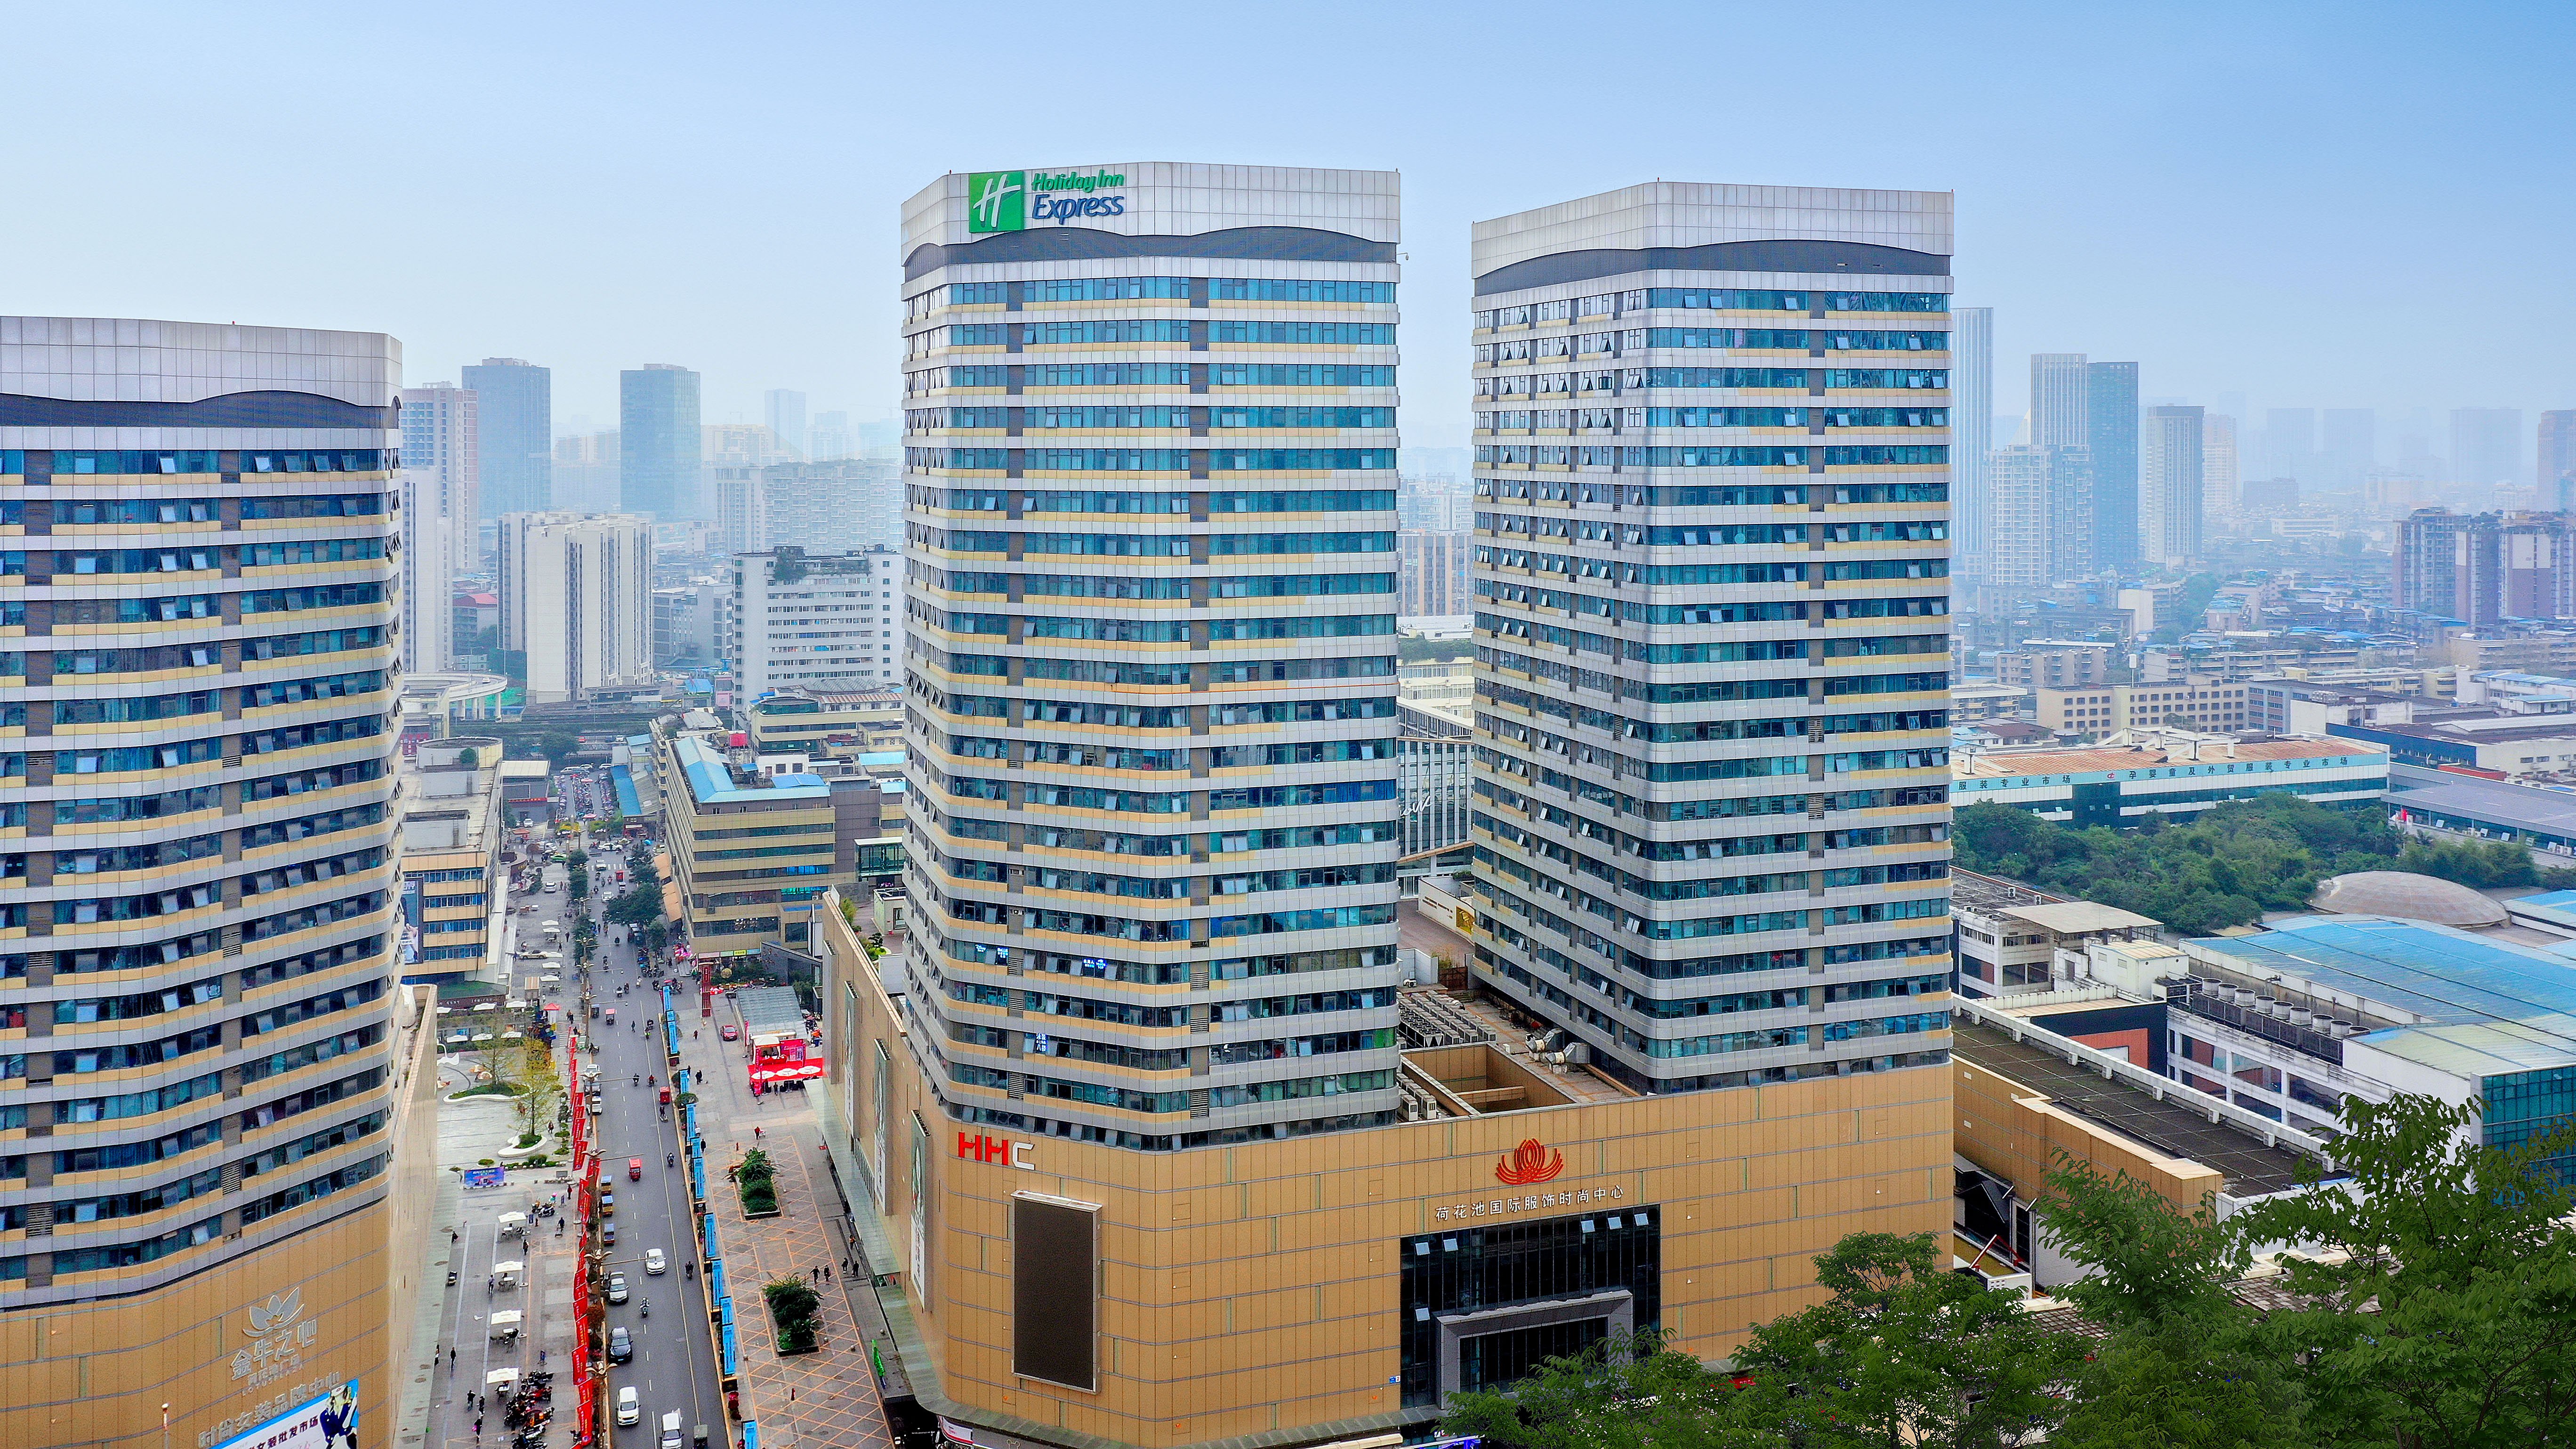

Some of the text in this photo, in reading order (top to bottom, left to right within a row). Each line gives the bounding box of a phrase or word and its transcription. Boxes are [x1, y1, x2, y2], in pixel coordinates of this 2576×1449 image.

[1031, 169, 1125, 193] Holiday Inn
[1031, 194, 1125, 225] Express
[1958, 774, 2071, 790] 服装专业市场
[2129, 757, 2348, 780] 孕婴童及外贸服装专业市场
[958, 1131, 1035, 1171] HHC
[1435, 1184, 1624, 1222] 荷花池国际服饰时尚中心
